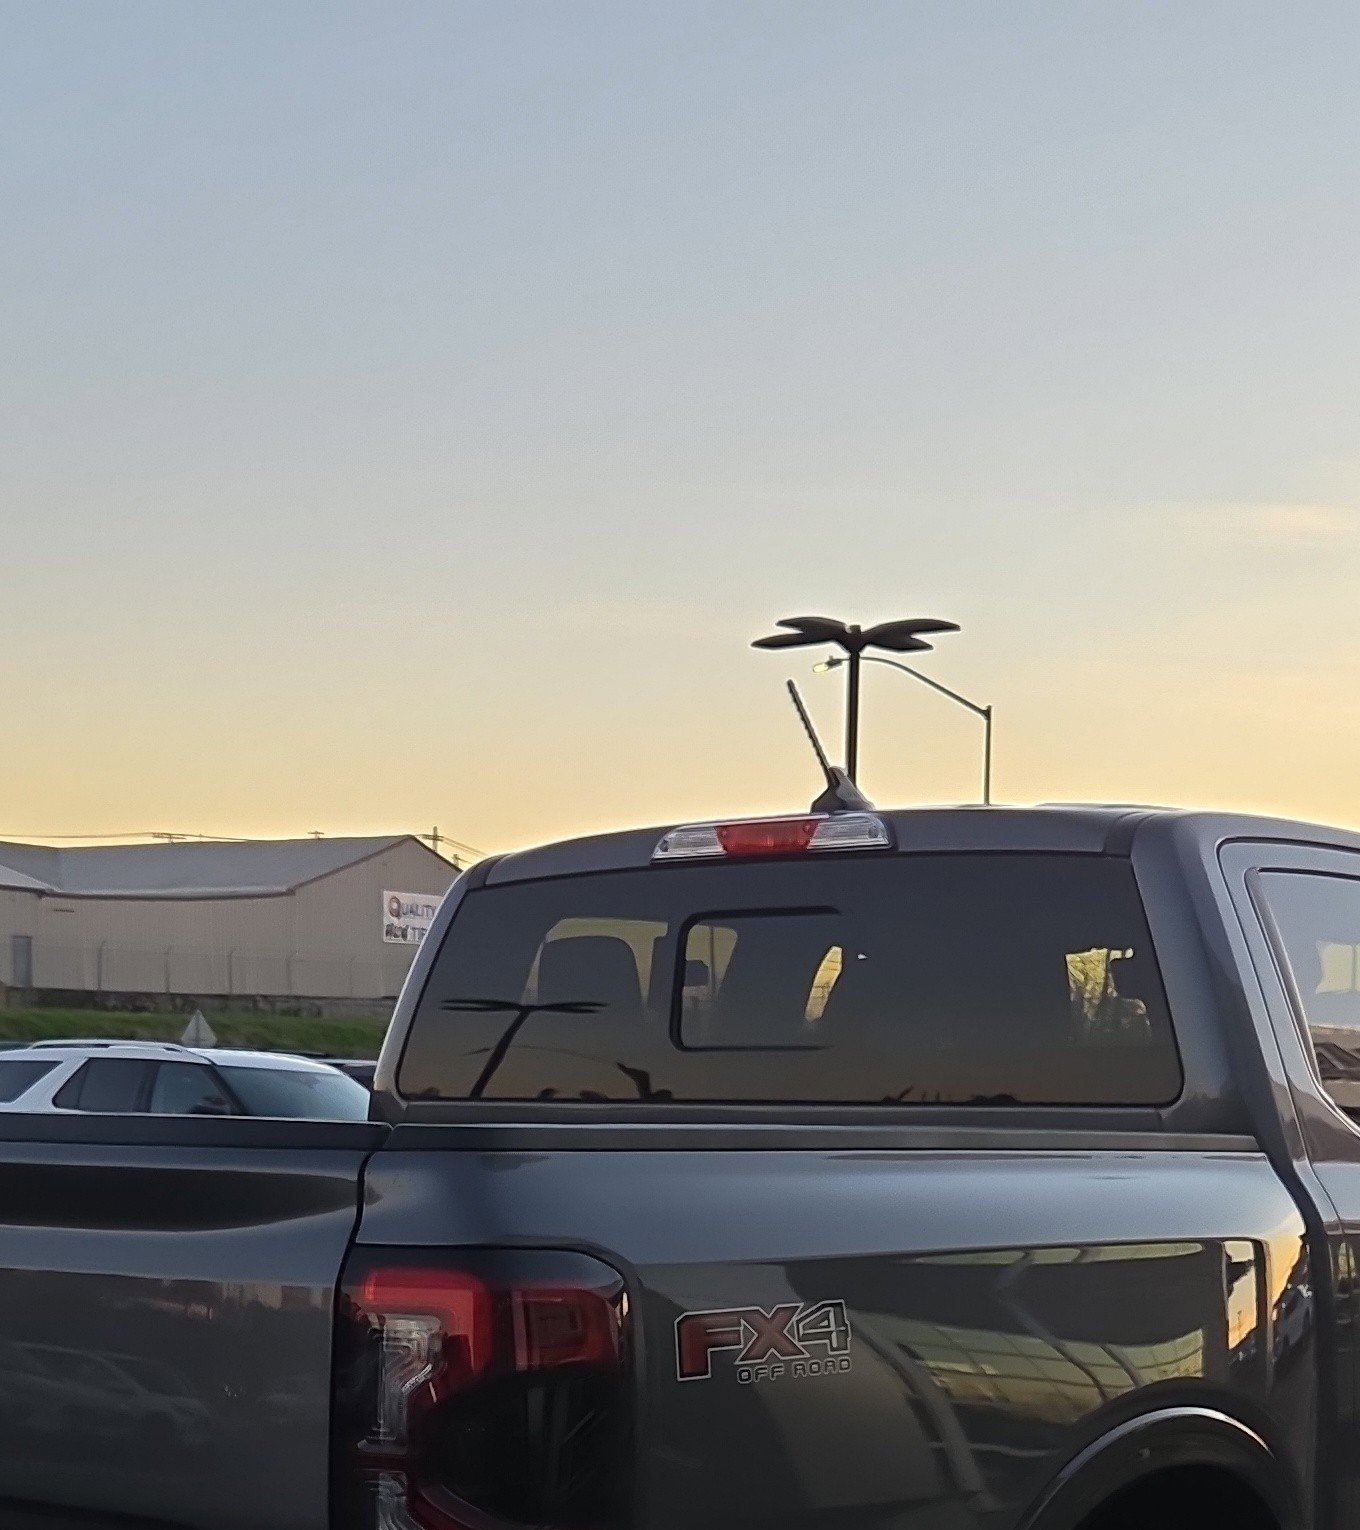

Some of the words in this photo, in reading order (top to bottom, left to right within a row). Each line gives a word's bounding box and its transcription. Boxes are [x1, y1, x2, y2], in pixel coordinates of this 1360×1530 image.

[674, 1299, 852, 1382] FX4
[737, 1363, 784, 1384] OFF
[793, 1357, 852, 1379] ROAD
